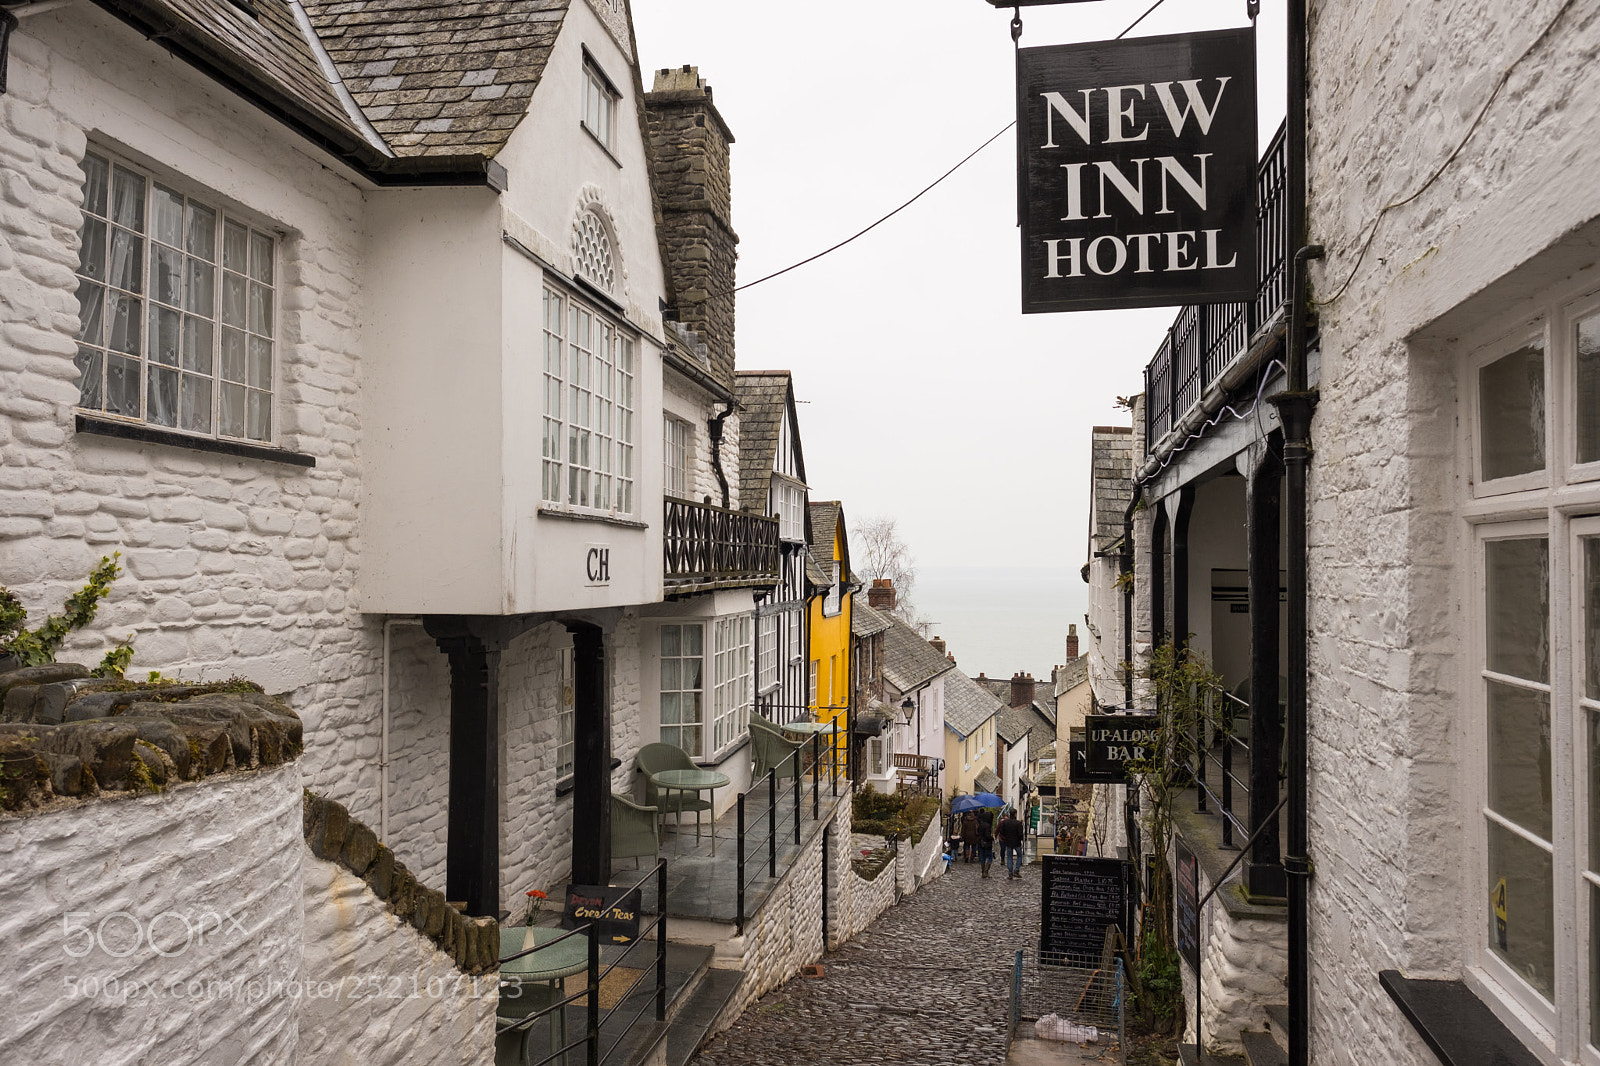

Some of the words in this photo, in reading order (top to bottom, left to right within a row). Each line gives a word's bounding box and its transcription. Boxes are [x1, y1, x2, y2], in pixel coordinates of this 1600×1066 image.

[1040, 76, 1232, 149] NEW
[1060, 153, 1213, 221] INN
[1043, 229, 1237, 279] HOTEL
[1107, 745, 1146, 760] BAR
[612, 907, 634, 920] Teas
